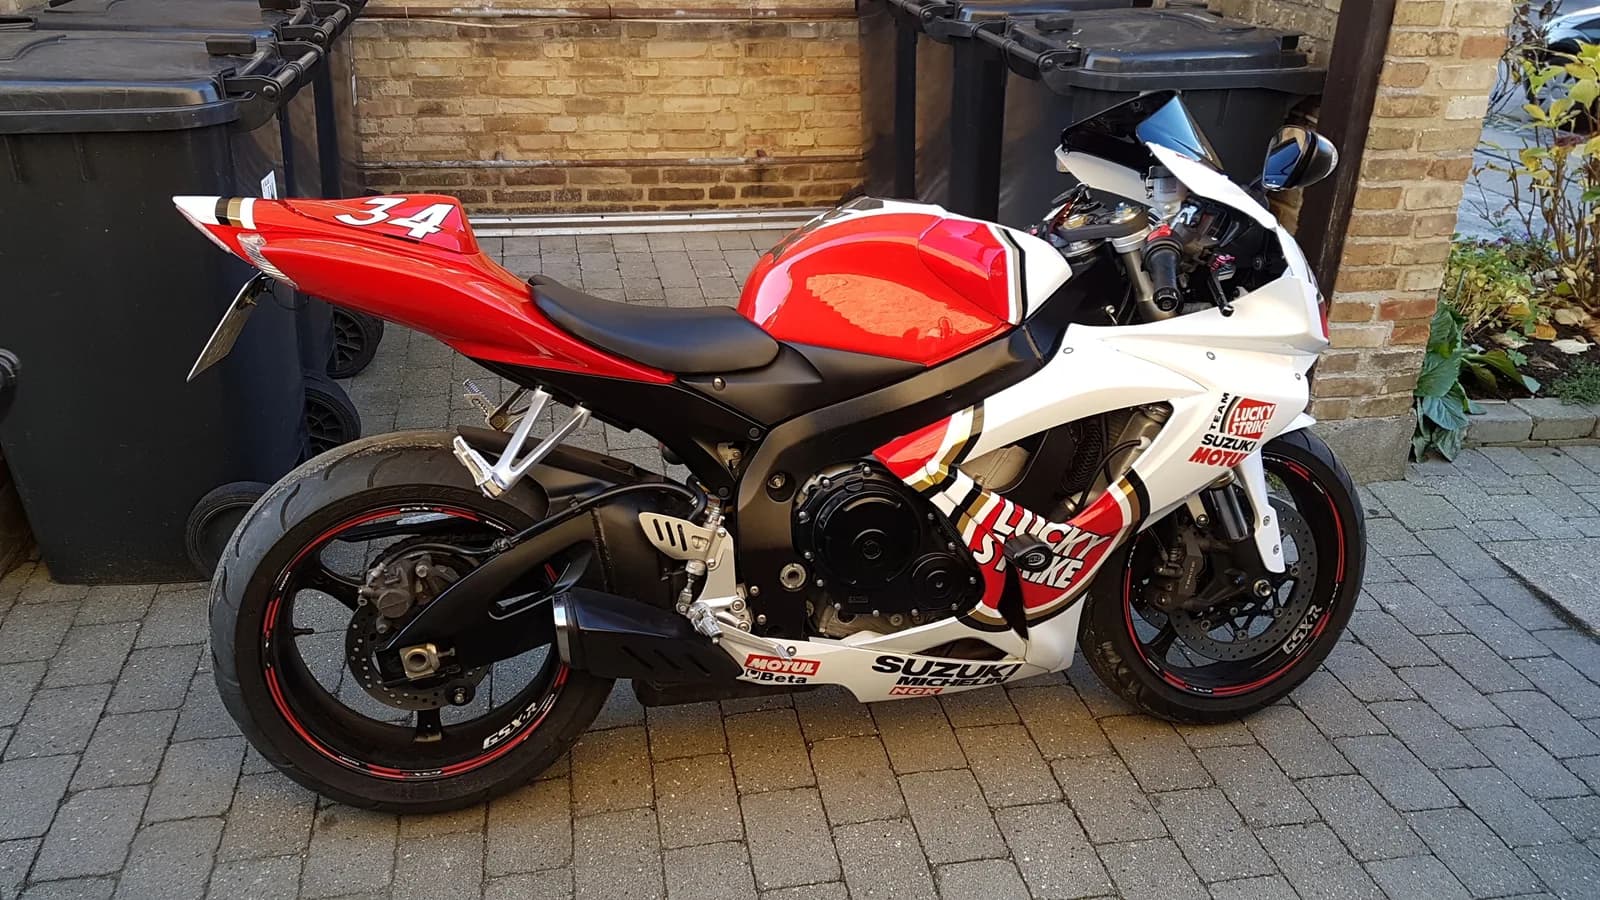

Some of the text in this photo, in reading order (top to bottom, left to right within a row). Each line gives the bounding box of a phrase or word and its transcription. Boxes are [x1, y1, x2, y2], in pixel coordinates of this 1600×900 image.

[333, 197, 455, 239] 34
[1209, 392, 1230, 431] TEAM
[1233, 405, 1275, 421] LUCKY
[1230, 420, 1269, 436] STRIKE
[1201, 433, 1257, 452] SUZUKI
[992, 498, 1111, 560] LUCKY
[972, 531, 1084, 590] SKE
[746, 657, 816, 674] MOTUL
[871, 655, 1024, 679] SUZUKI
[759, 672, 808, 684] Beta
[895, 676, 1009, 687] MICHELIN
[890, 687, 943, 696] NGK
